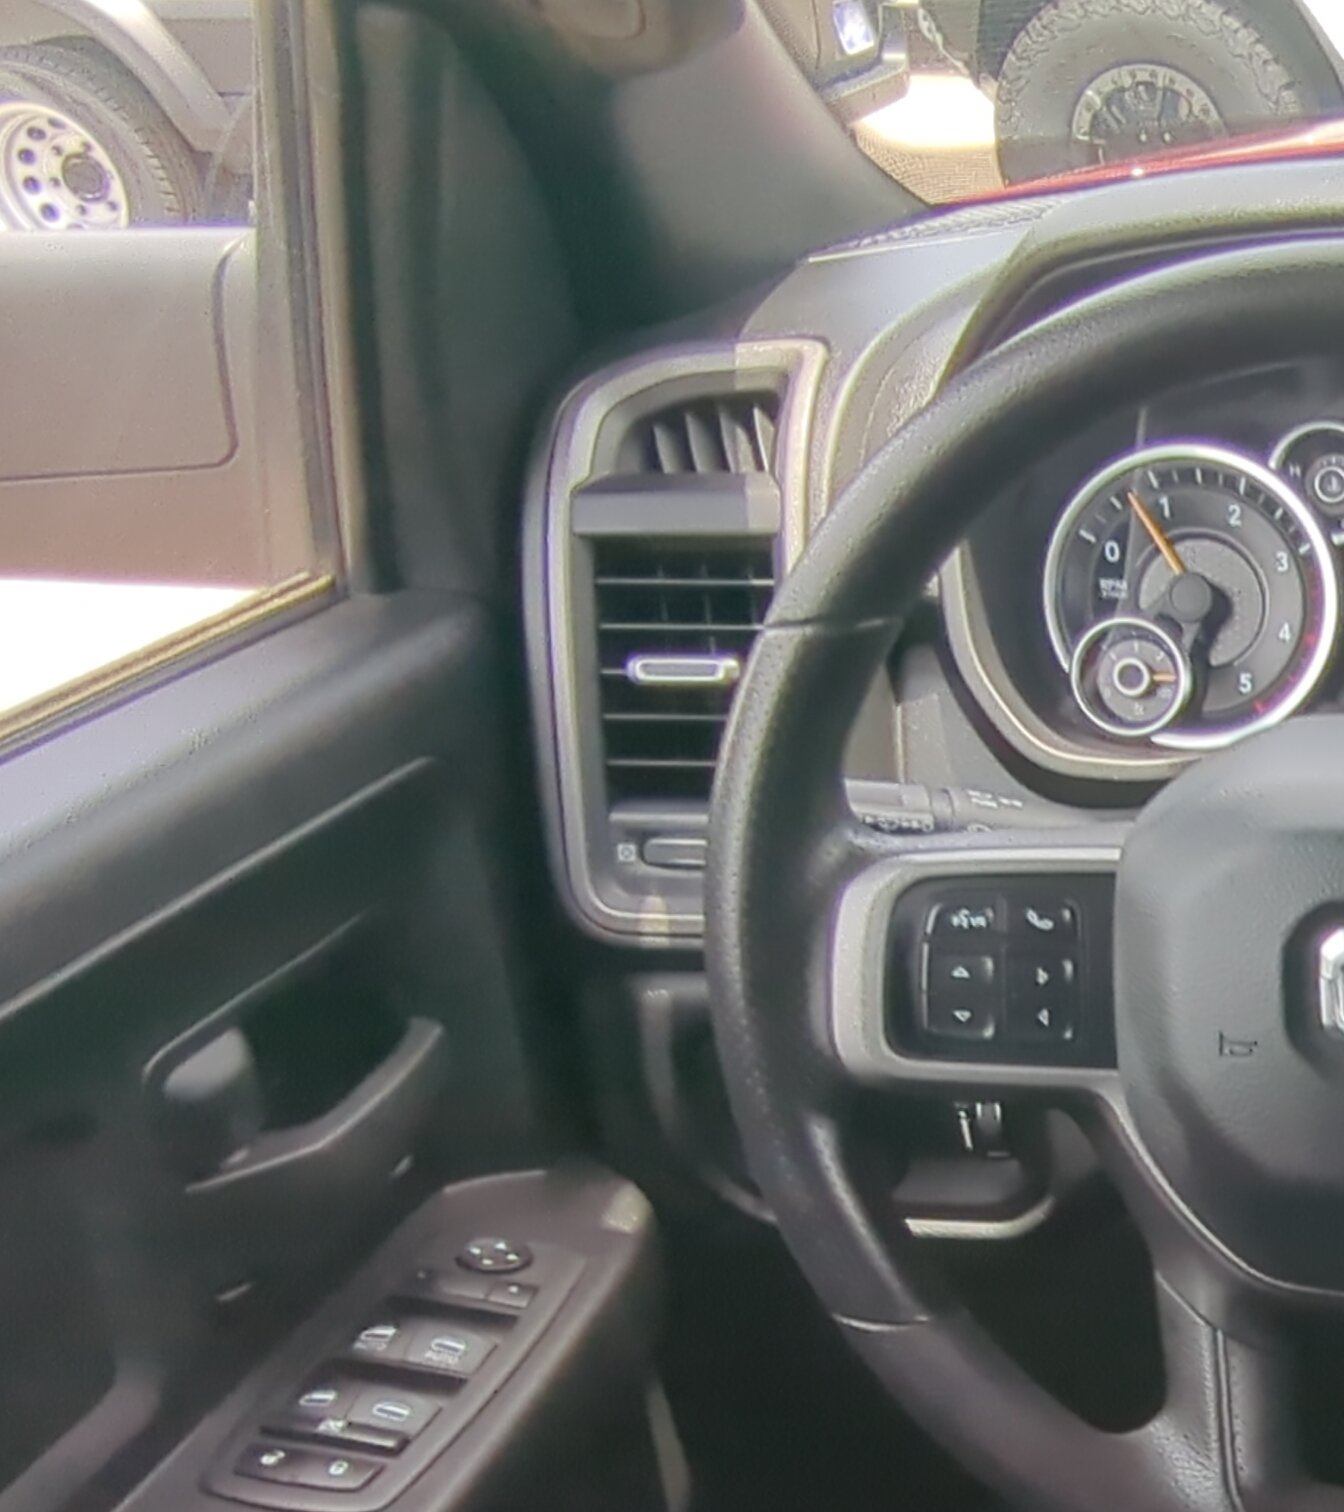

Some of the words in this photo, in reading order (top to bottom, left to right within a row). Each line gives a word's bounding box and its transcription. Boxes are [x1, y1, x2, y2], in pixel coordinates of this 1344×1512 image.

[1160, 498, 1172, 518] 1
[1228, 505, 1241, 527] 2
[1105, 541, 1120, 563] 0
[1276, 552, 1289, 571] 3
[1278, 625, 1291, 642] 4
[1239, 674, 1252, 694] 5
